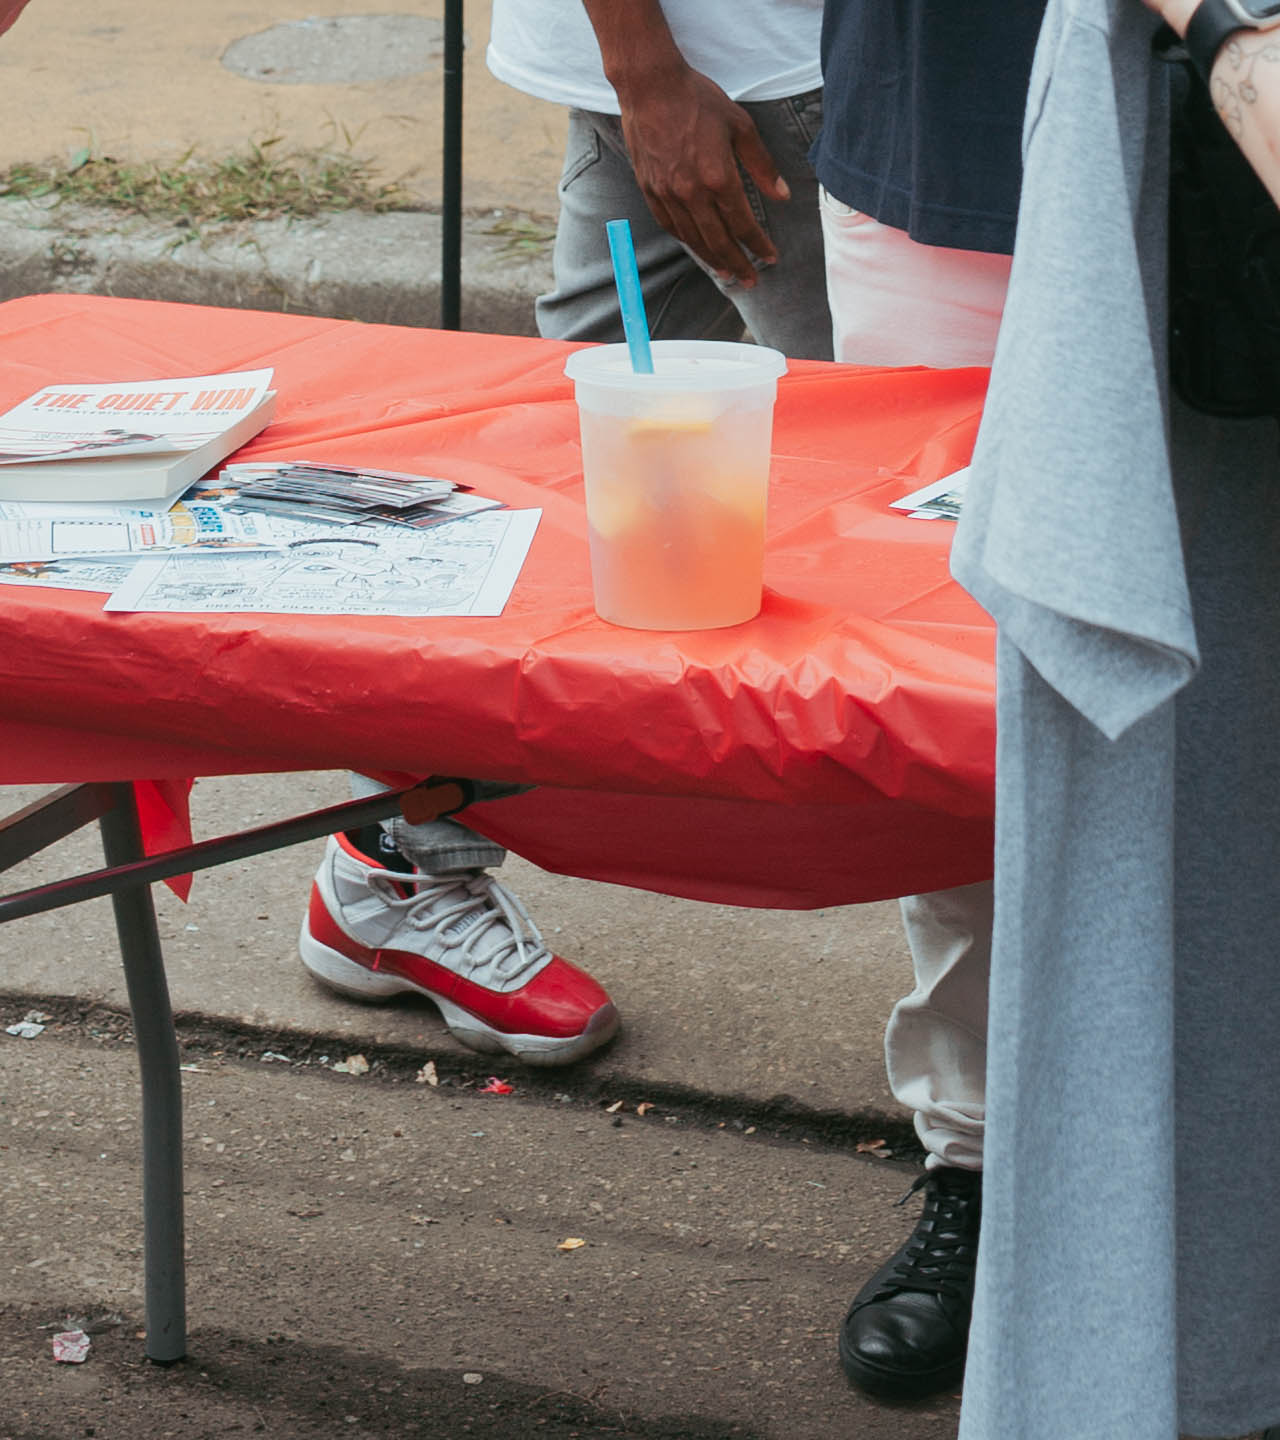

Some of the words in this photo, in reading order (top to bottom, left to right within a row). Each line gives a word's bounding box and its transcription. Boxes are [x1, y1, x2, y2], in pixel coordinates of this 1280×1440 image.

[32, 393, 97, 410] THE
[95, 392, 190, 411] QUIET
[190, 387, 257, 411] WIN
